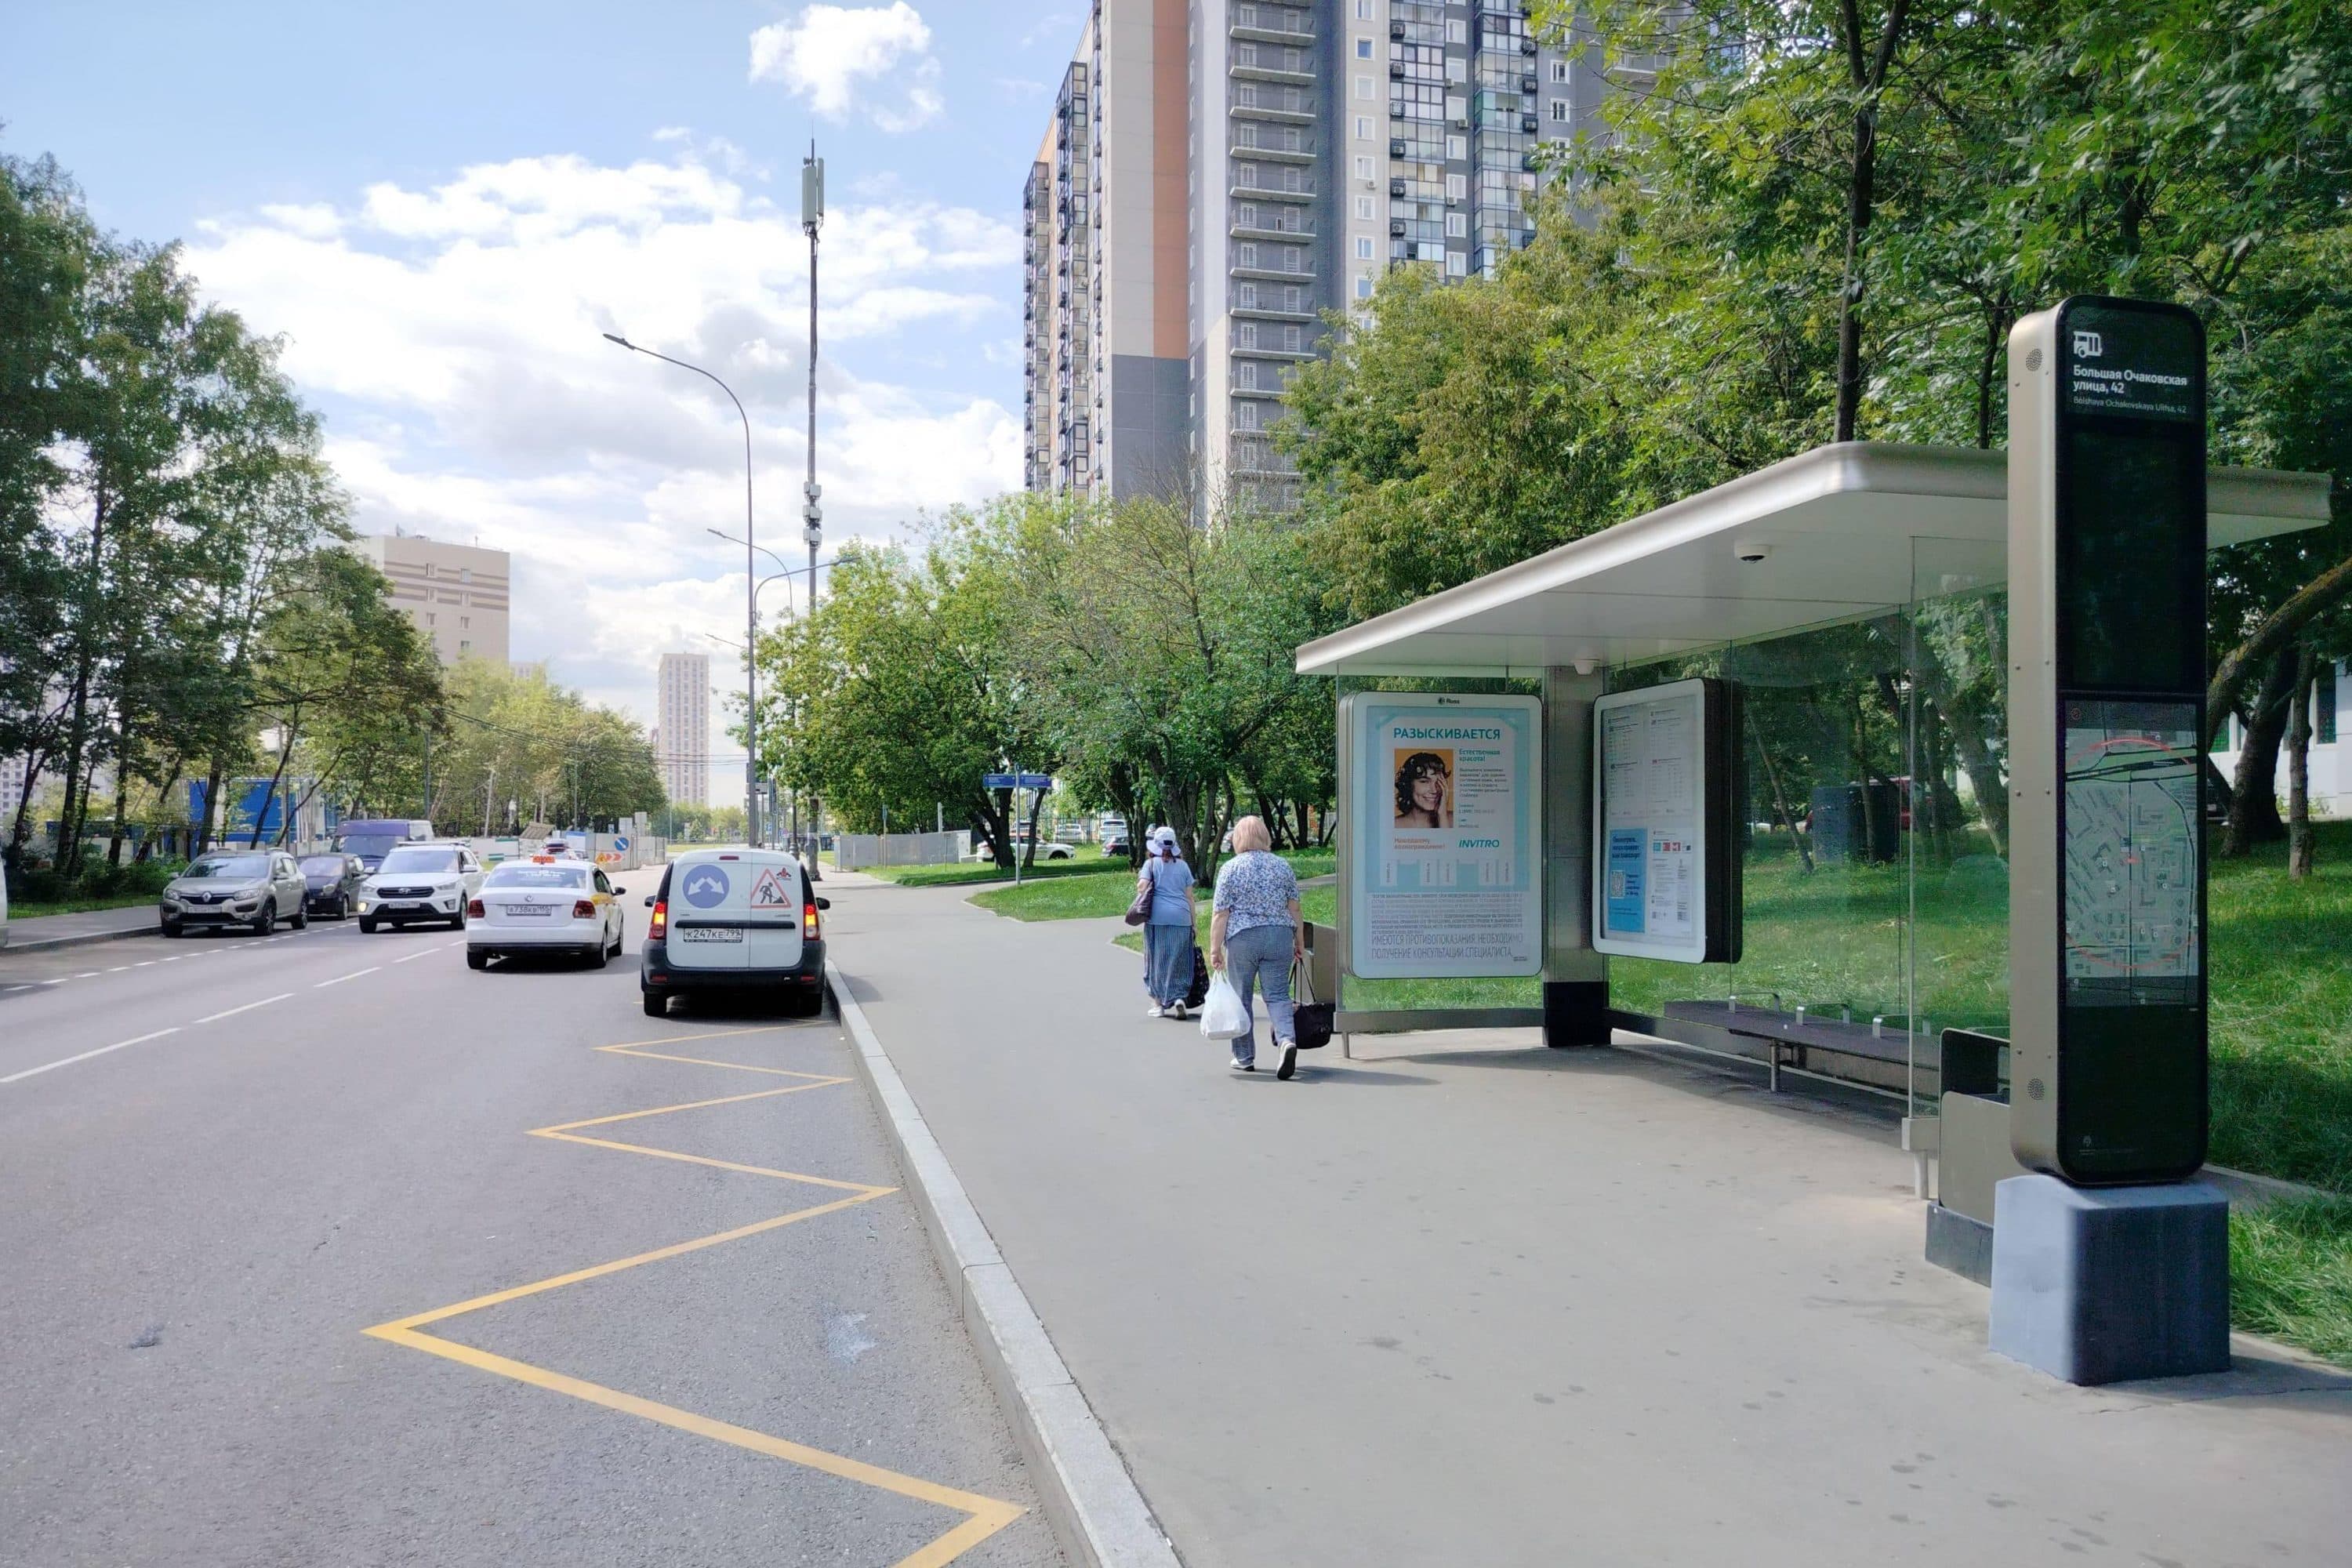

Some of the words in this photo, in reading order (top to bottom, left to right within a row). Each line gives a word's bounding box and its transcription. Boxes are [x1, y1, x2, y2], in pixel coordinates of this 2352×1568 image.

[2073, 364, 2122, 380] Большая
[2124, 369, 2187, 385] Очаковская
[2073, 380, 2108, 394] улица,
[2111, 382, 2125, 394] 42
[2073, 396, 2104, 407] Bolshaya
[2105, 399, 2154, 411] Ochakovskaya
[1393, 728, 1501, 740] РАЗЫСКИВАЕТСЯ
[1458, 839, 1500, 848] INVITRO
[1371, 934, 1404, 946] ИМЕЮТСЯ
[1371, 947, 1412, 959] ПОЛУЧЕНИЕ
